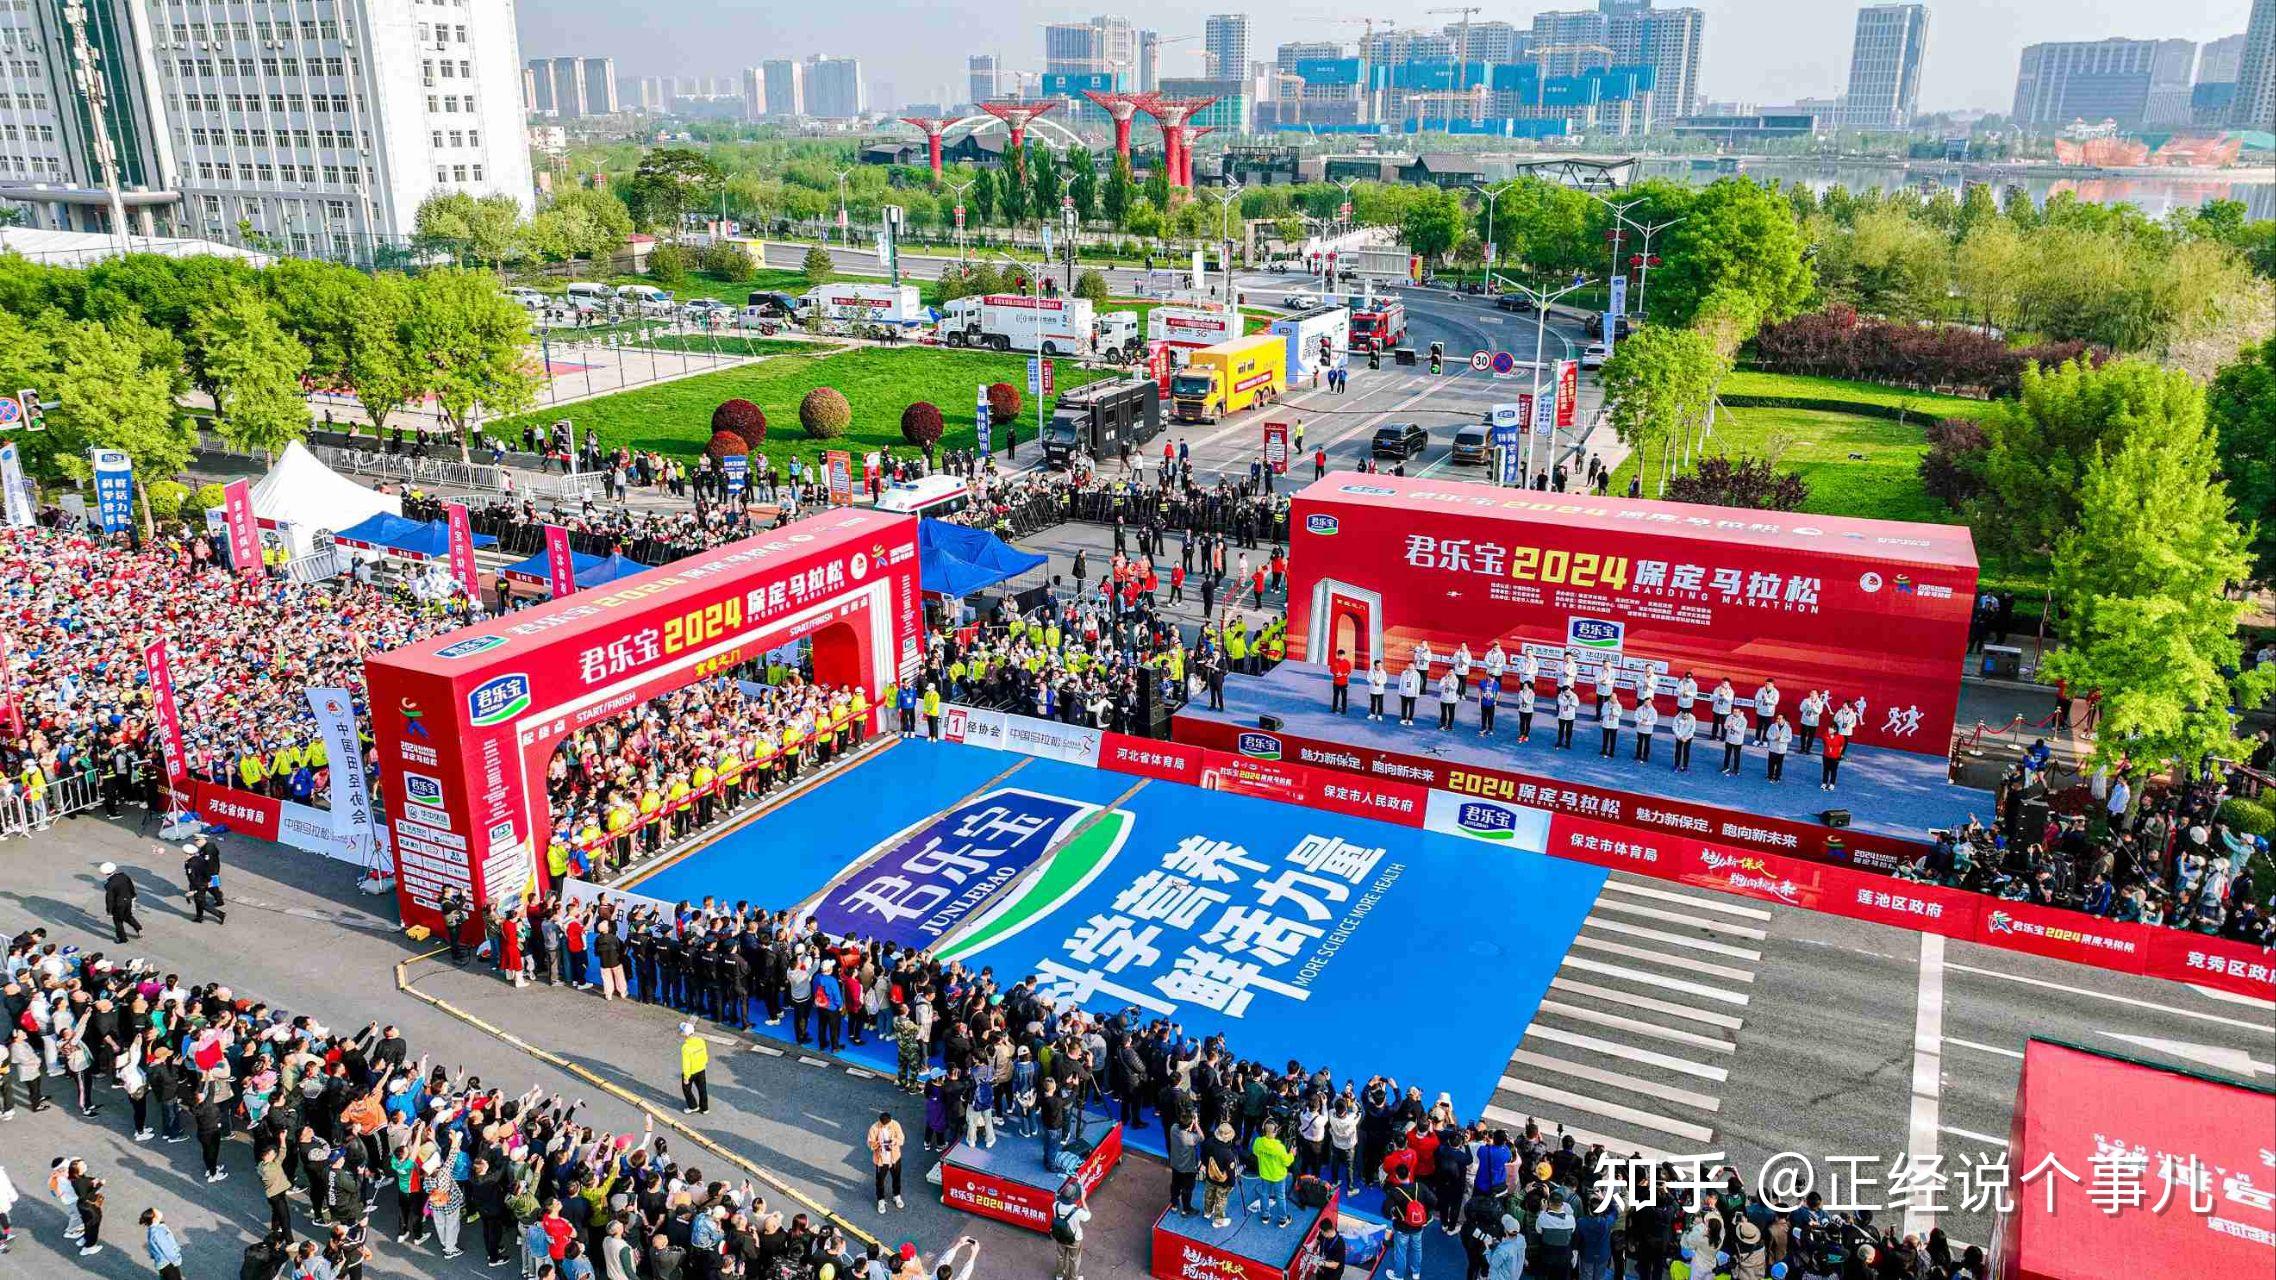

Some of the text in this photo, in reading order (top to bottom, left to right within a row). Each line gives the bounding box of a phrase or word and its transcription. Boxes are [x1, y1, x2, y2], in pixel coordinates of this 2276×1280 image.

[1475, 355, 1488, 366] 30
[1632, 584, 1709, 602] BAODING
[1722, 595, 1820, 615] MARATHON
[477, 678, 522, 709] 君乐宝
[576, 692, 636, 723] START/FINISH
[336, 722, 367, 826] 中国田径协会
[1116, 748, 1186, 771] 河北省体育局
[411, 778, 437, 795] 君乐宝
[1323, 785, 1413, 813] 保定市人民政府
[208, 798, 265, 825] 河北省体育局
[1465, 805, 1511, 828] 君乐宝
[1570, 832, 1659, 862] 保定市体育局
[838, 806, 1055, 924] 君乐宝
[917, 866, 1017, 937] JUNLEBAO
[1856, 888, 1943, 918] 莲池区政府
[1034, 834, 1273, 1022] 科学营养
[1151, 833, 1387, 1019] 鲜活力量
[1291, 862, 1407, 988] MORE SCIENCE MORE HEALTH
